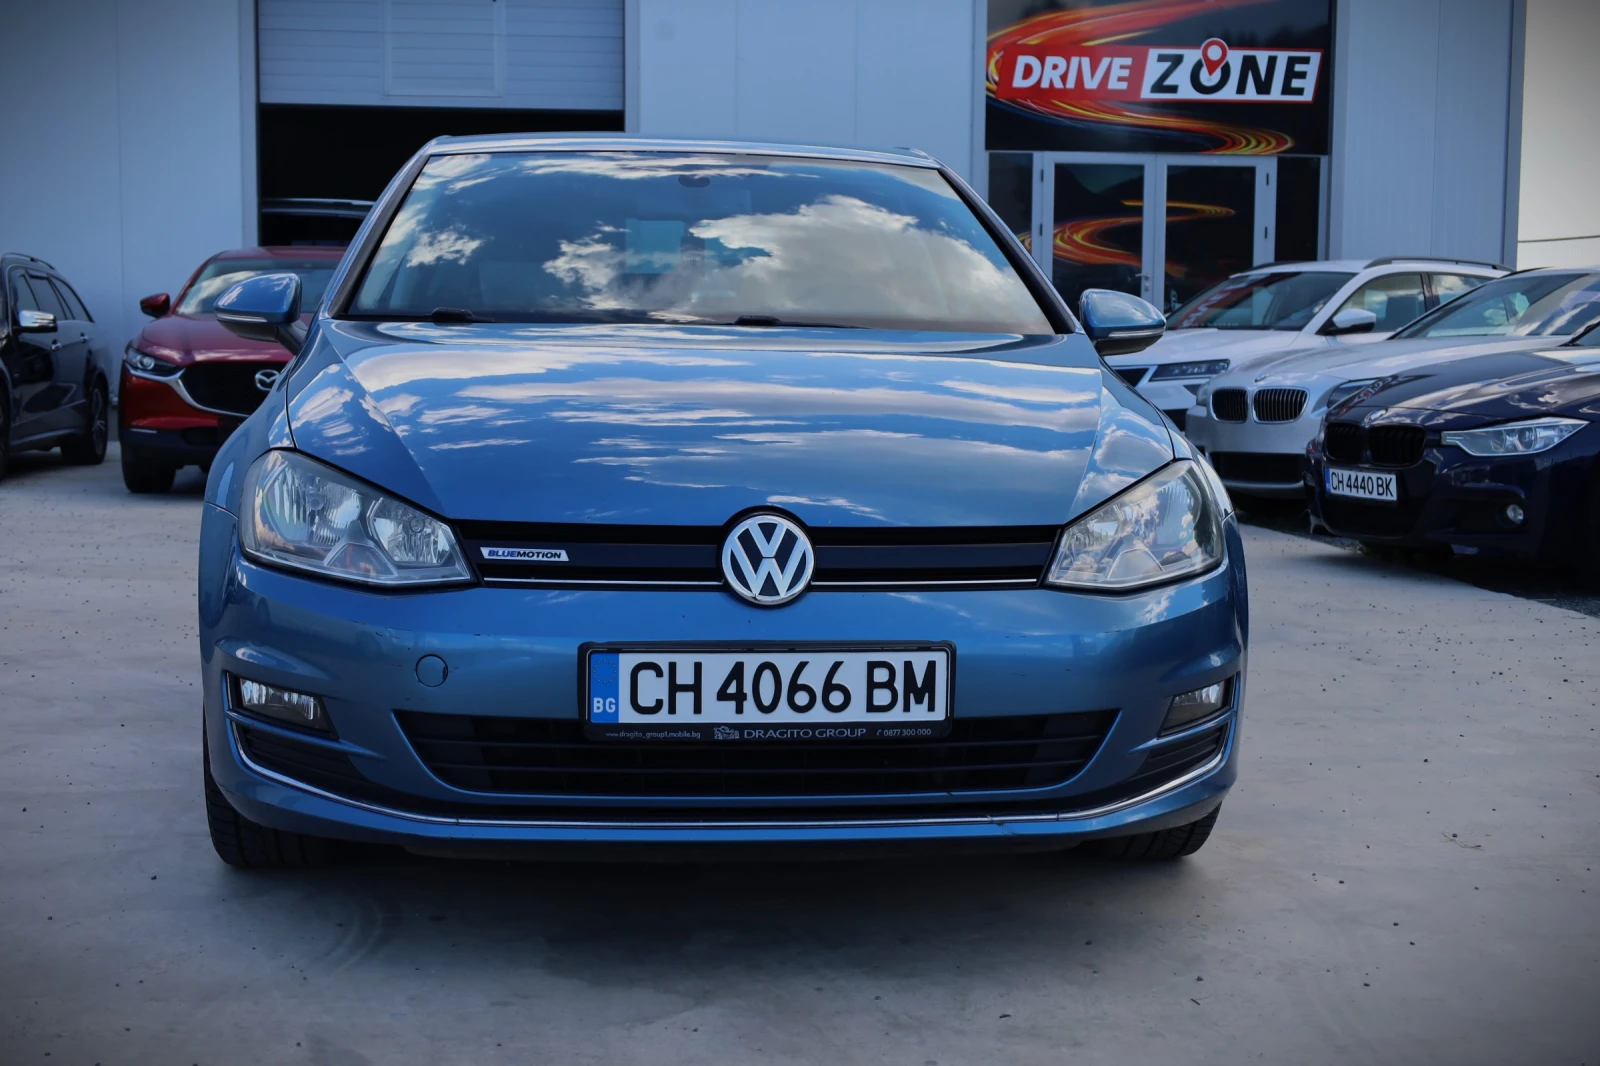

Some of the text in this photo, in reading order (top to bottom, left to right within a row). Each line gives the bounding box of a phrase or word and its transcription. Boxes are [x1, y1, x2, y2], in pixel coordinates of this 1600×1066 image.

[1012, 52, 1312, 96] DRIVE ZONE
[1331, 472, 1394, 497] CH 4440 BK
[488, 549, 561, 559] BLUEMOTION
[629, 660, 937, 715] CH 4066 BM
[593, 697, 617, 713] BG
[744, 729, 813, 739] DRAGITO
[815, 728, 867, 738] GROUP
[883, 729, 901, 737] 0877
[917, 728, 932, 736] 000
